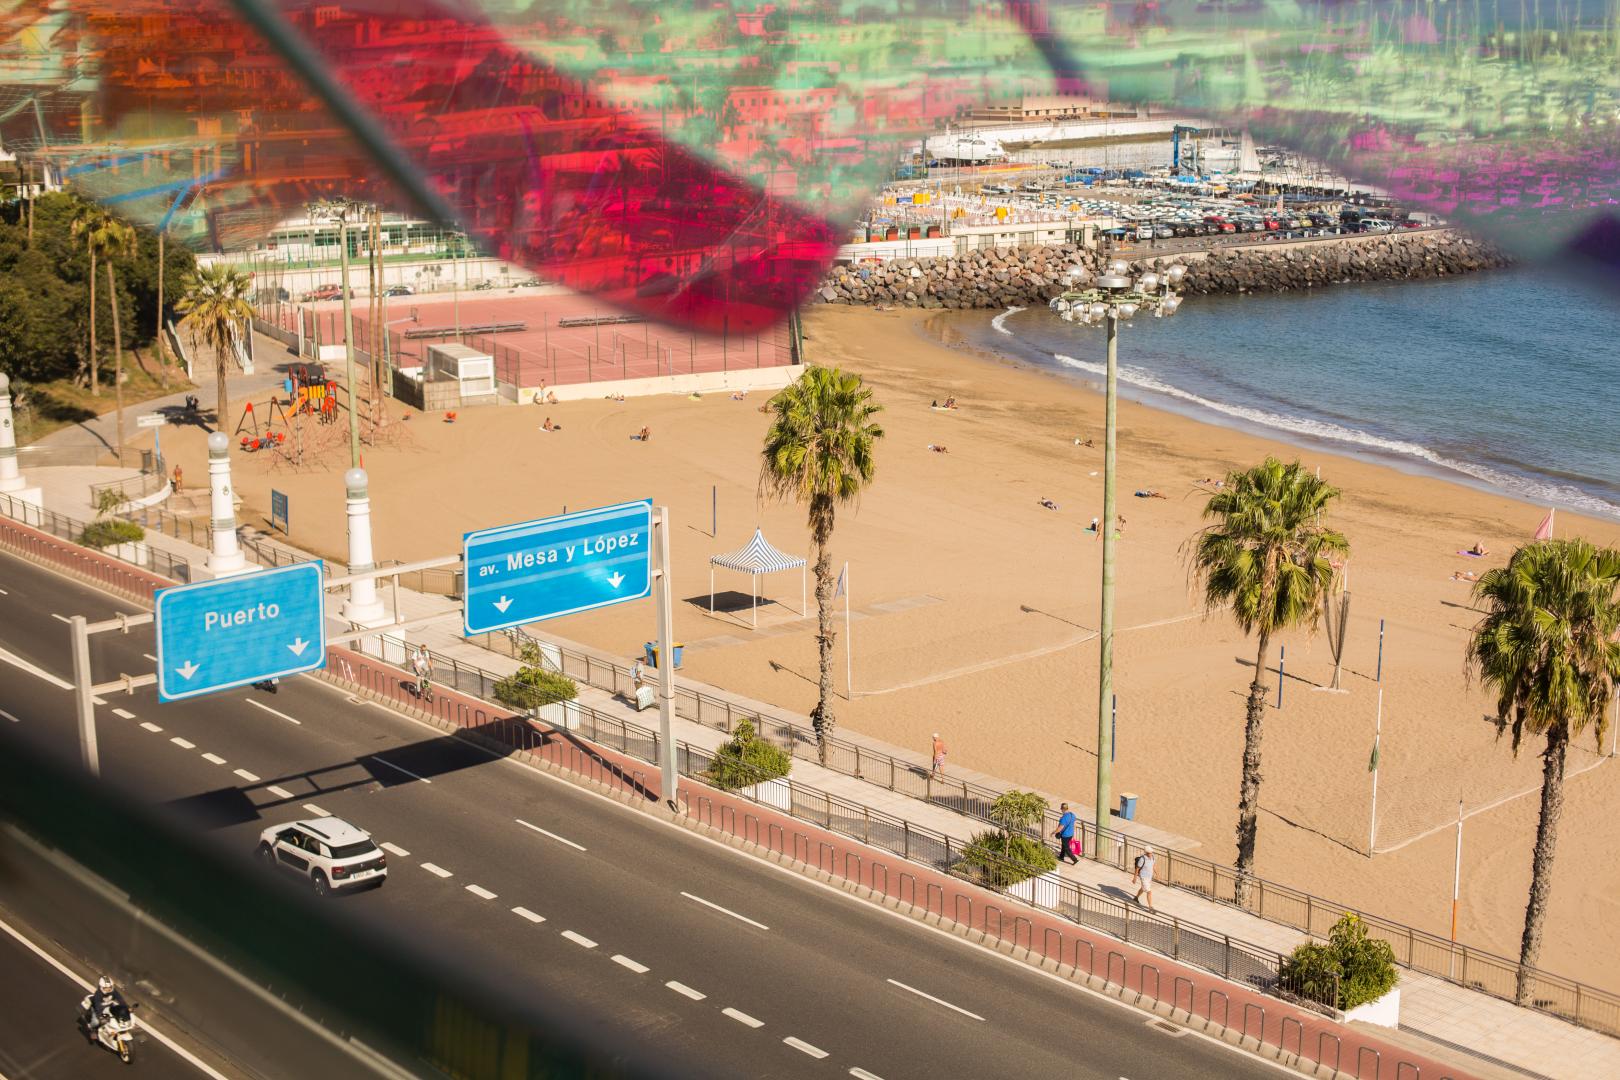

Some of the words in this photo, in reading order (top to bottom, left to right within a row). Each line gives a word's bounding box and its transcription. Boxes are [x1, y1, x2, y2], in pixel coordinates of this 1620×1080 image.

[479, 564, 499, 577] av.
[507, 549, 558, 571] Mesa
[565, 545, 576, 563] y
[583, 532, 639, 556] López
[205, 602, 280, 632] Puerto
